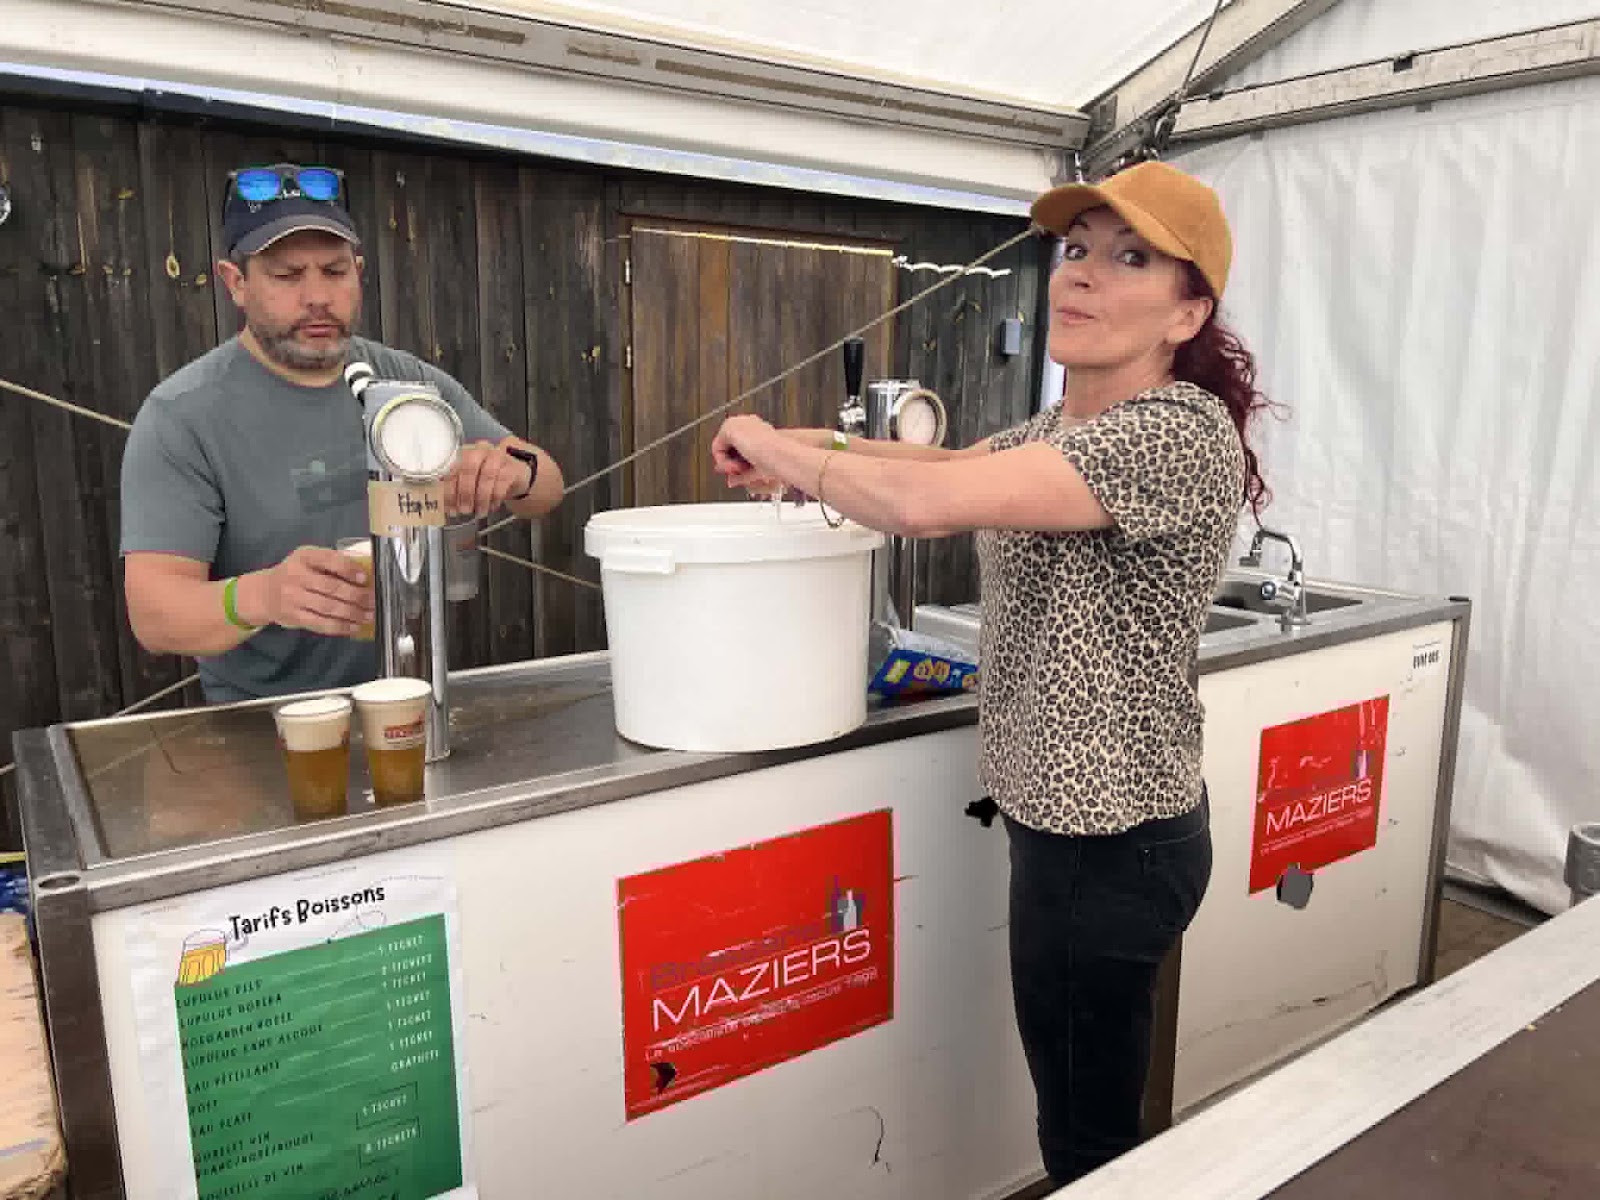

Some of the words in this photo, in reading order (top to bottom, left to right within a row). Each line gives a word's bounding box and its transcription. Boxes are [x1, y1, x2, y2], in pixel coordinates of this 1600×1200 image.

[1266, 778, 1372, 836] MAZIERS
[229, 905, 293, 940] Tarifs
[296, 887, 386, 925] Boissons
[652, 927, 872, 1032] MAZIERS
